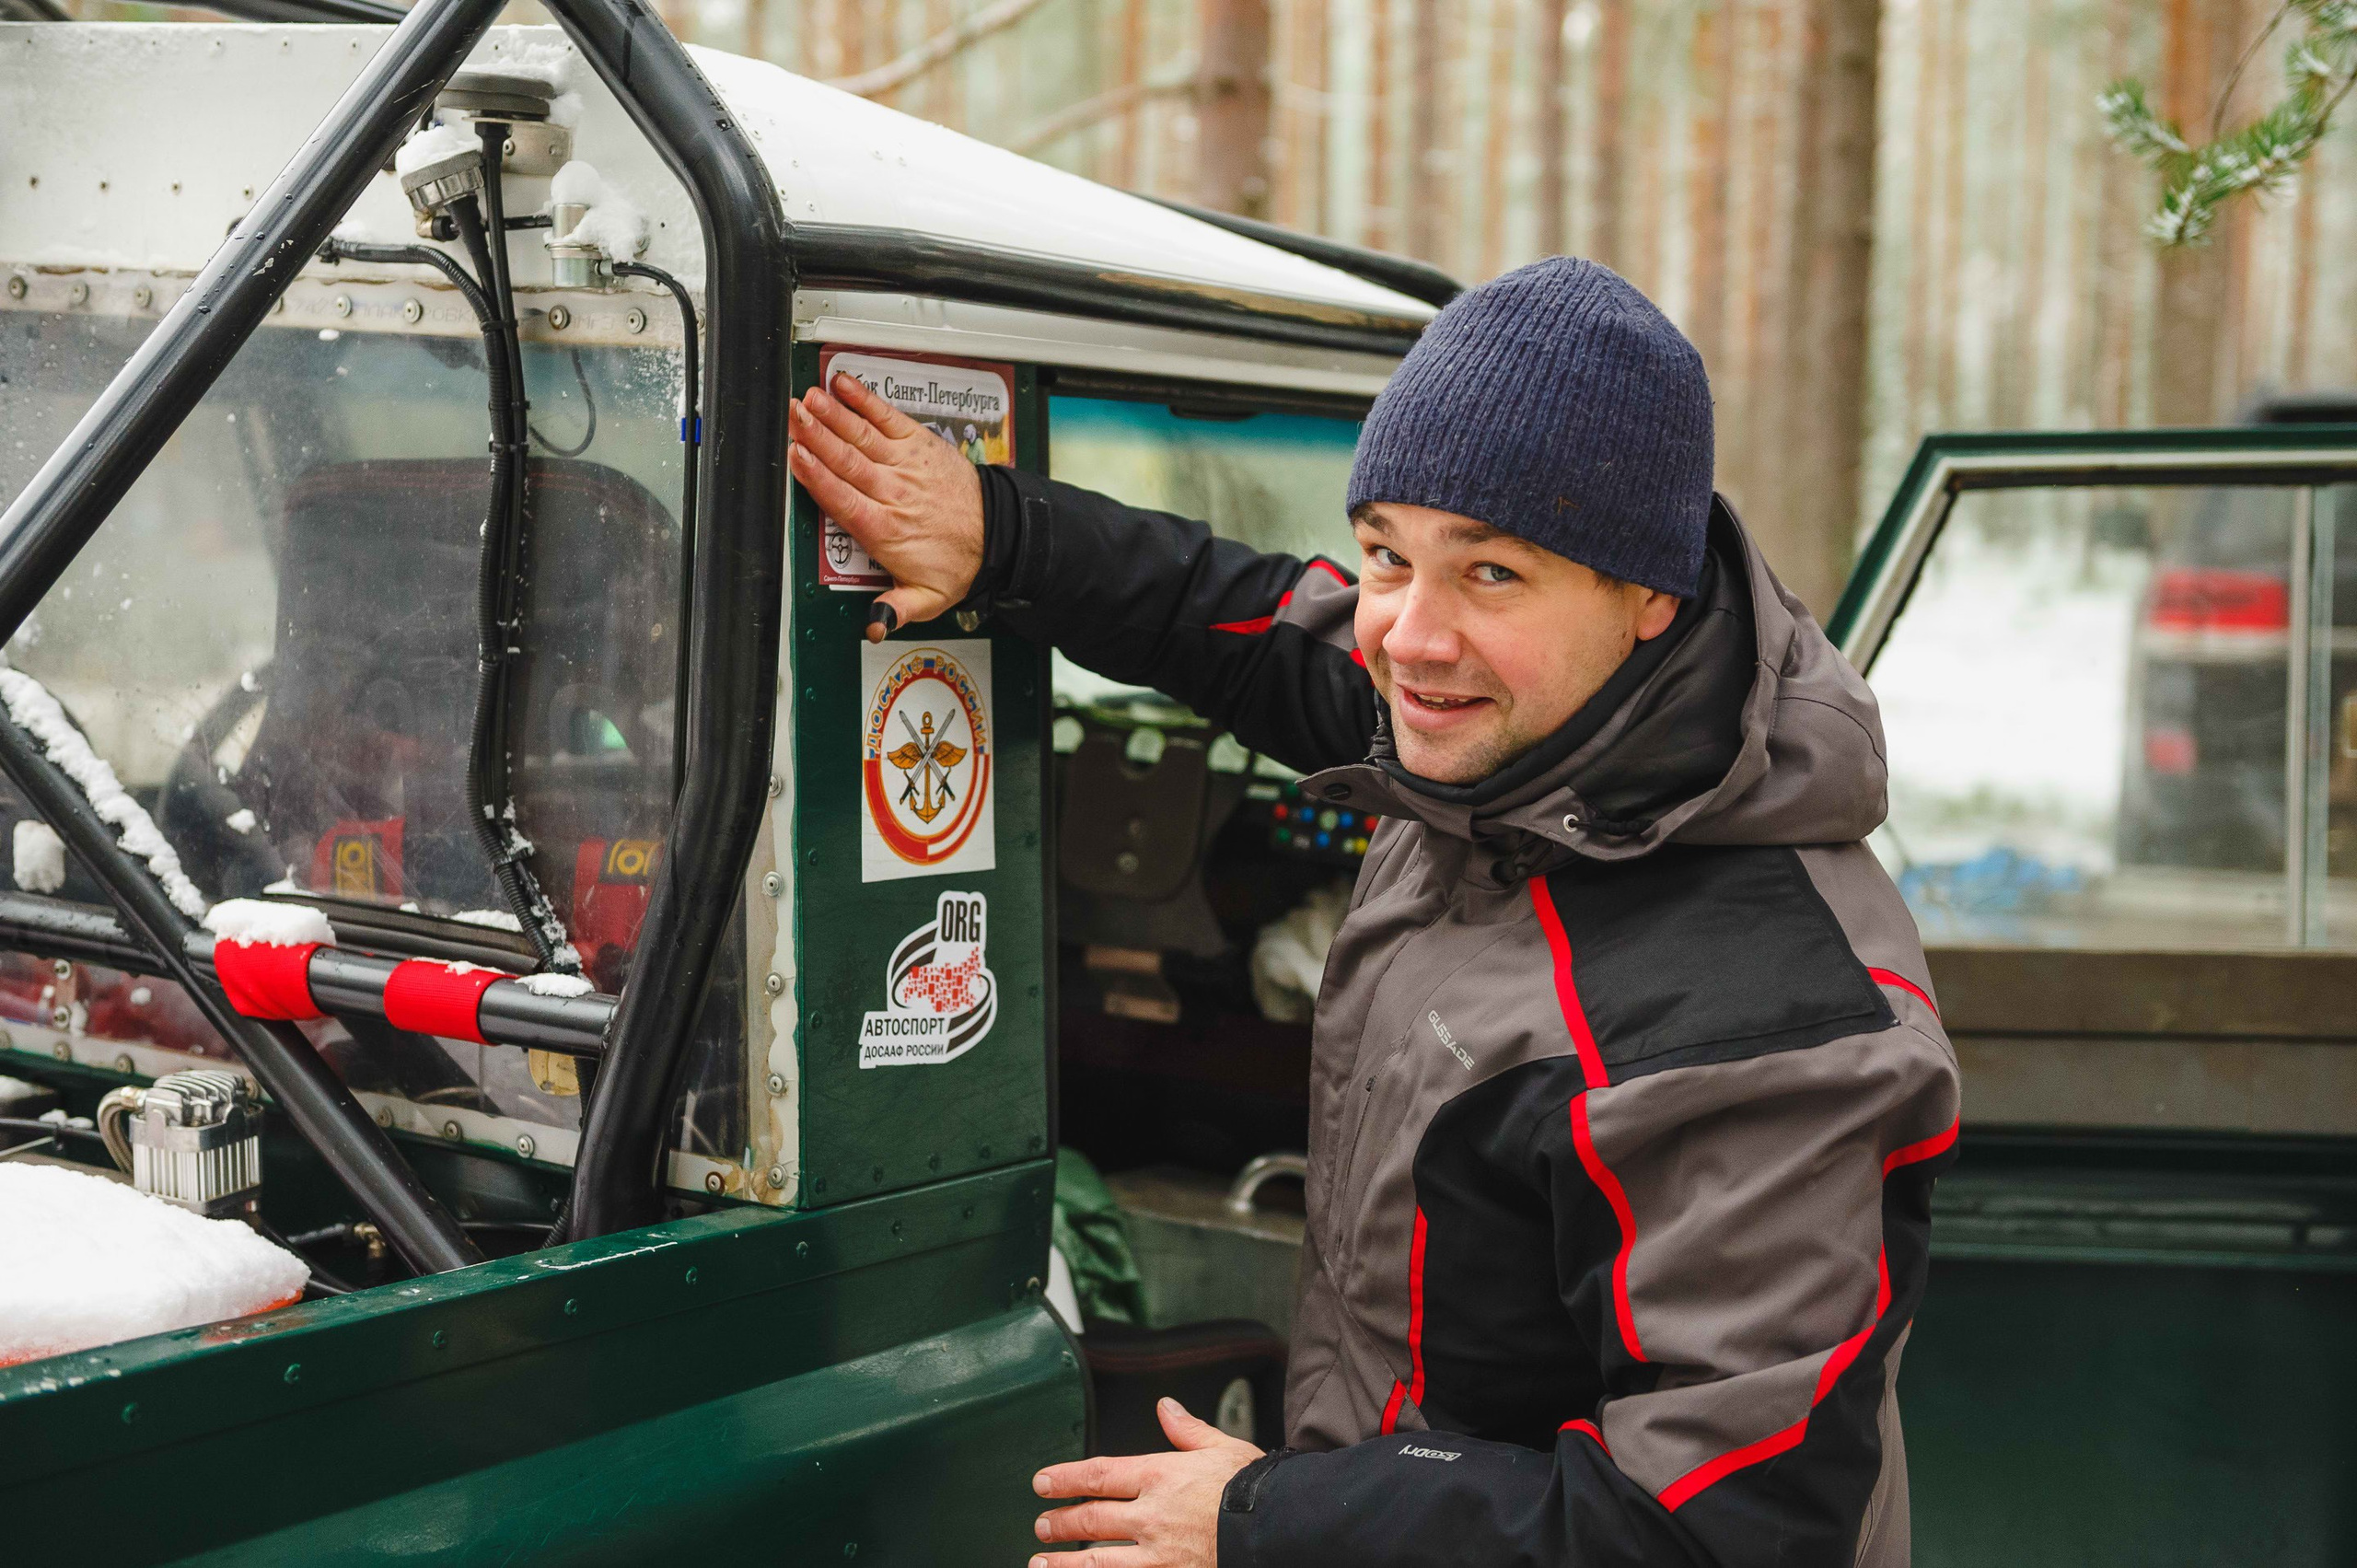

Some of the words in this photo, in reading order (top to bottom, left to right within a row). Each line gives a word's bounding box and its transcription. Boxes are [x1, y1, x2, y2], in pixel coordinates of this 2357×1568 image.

[884, 376, 1000, 414] Санкт-Петербурга
[866, 655, 924, 752] ДОСААФ
[933, 655, 988, 747] РОССИИ
[941, 900, 981, 943] ORG
[865, 1017, 945, 1037] АВТОСПОРТ
[864, 1045, 903, 1061] ДОСААФ
[906, 1043, 944, 1057] РОССИИ
